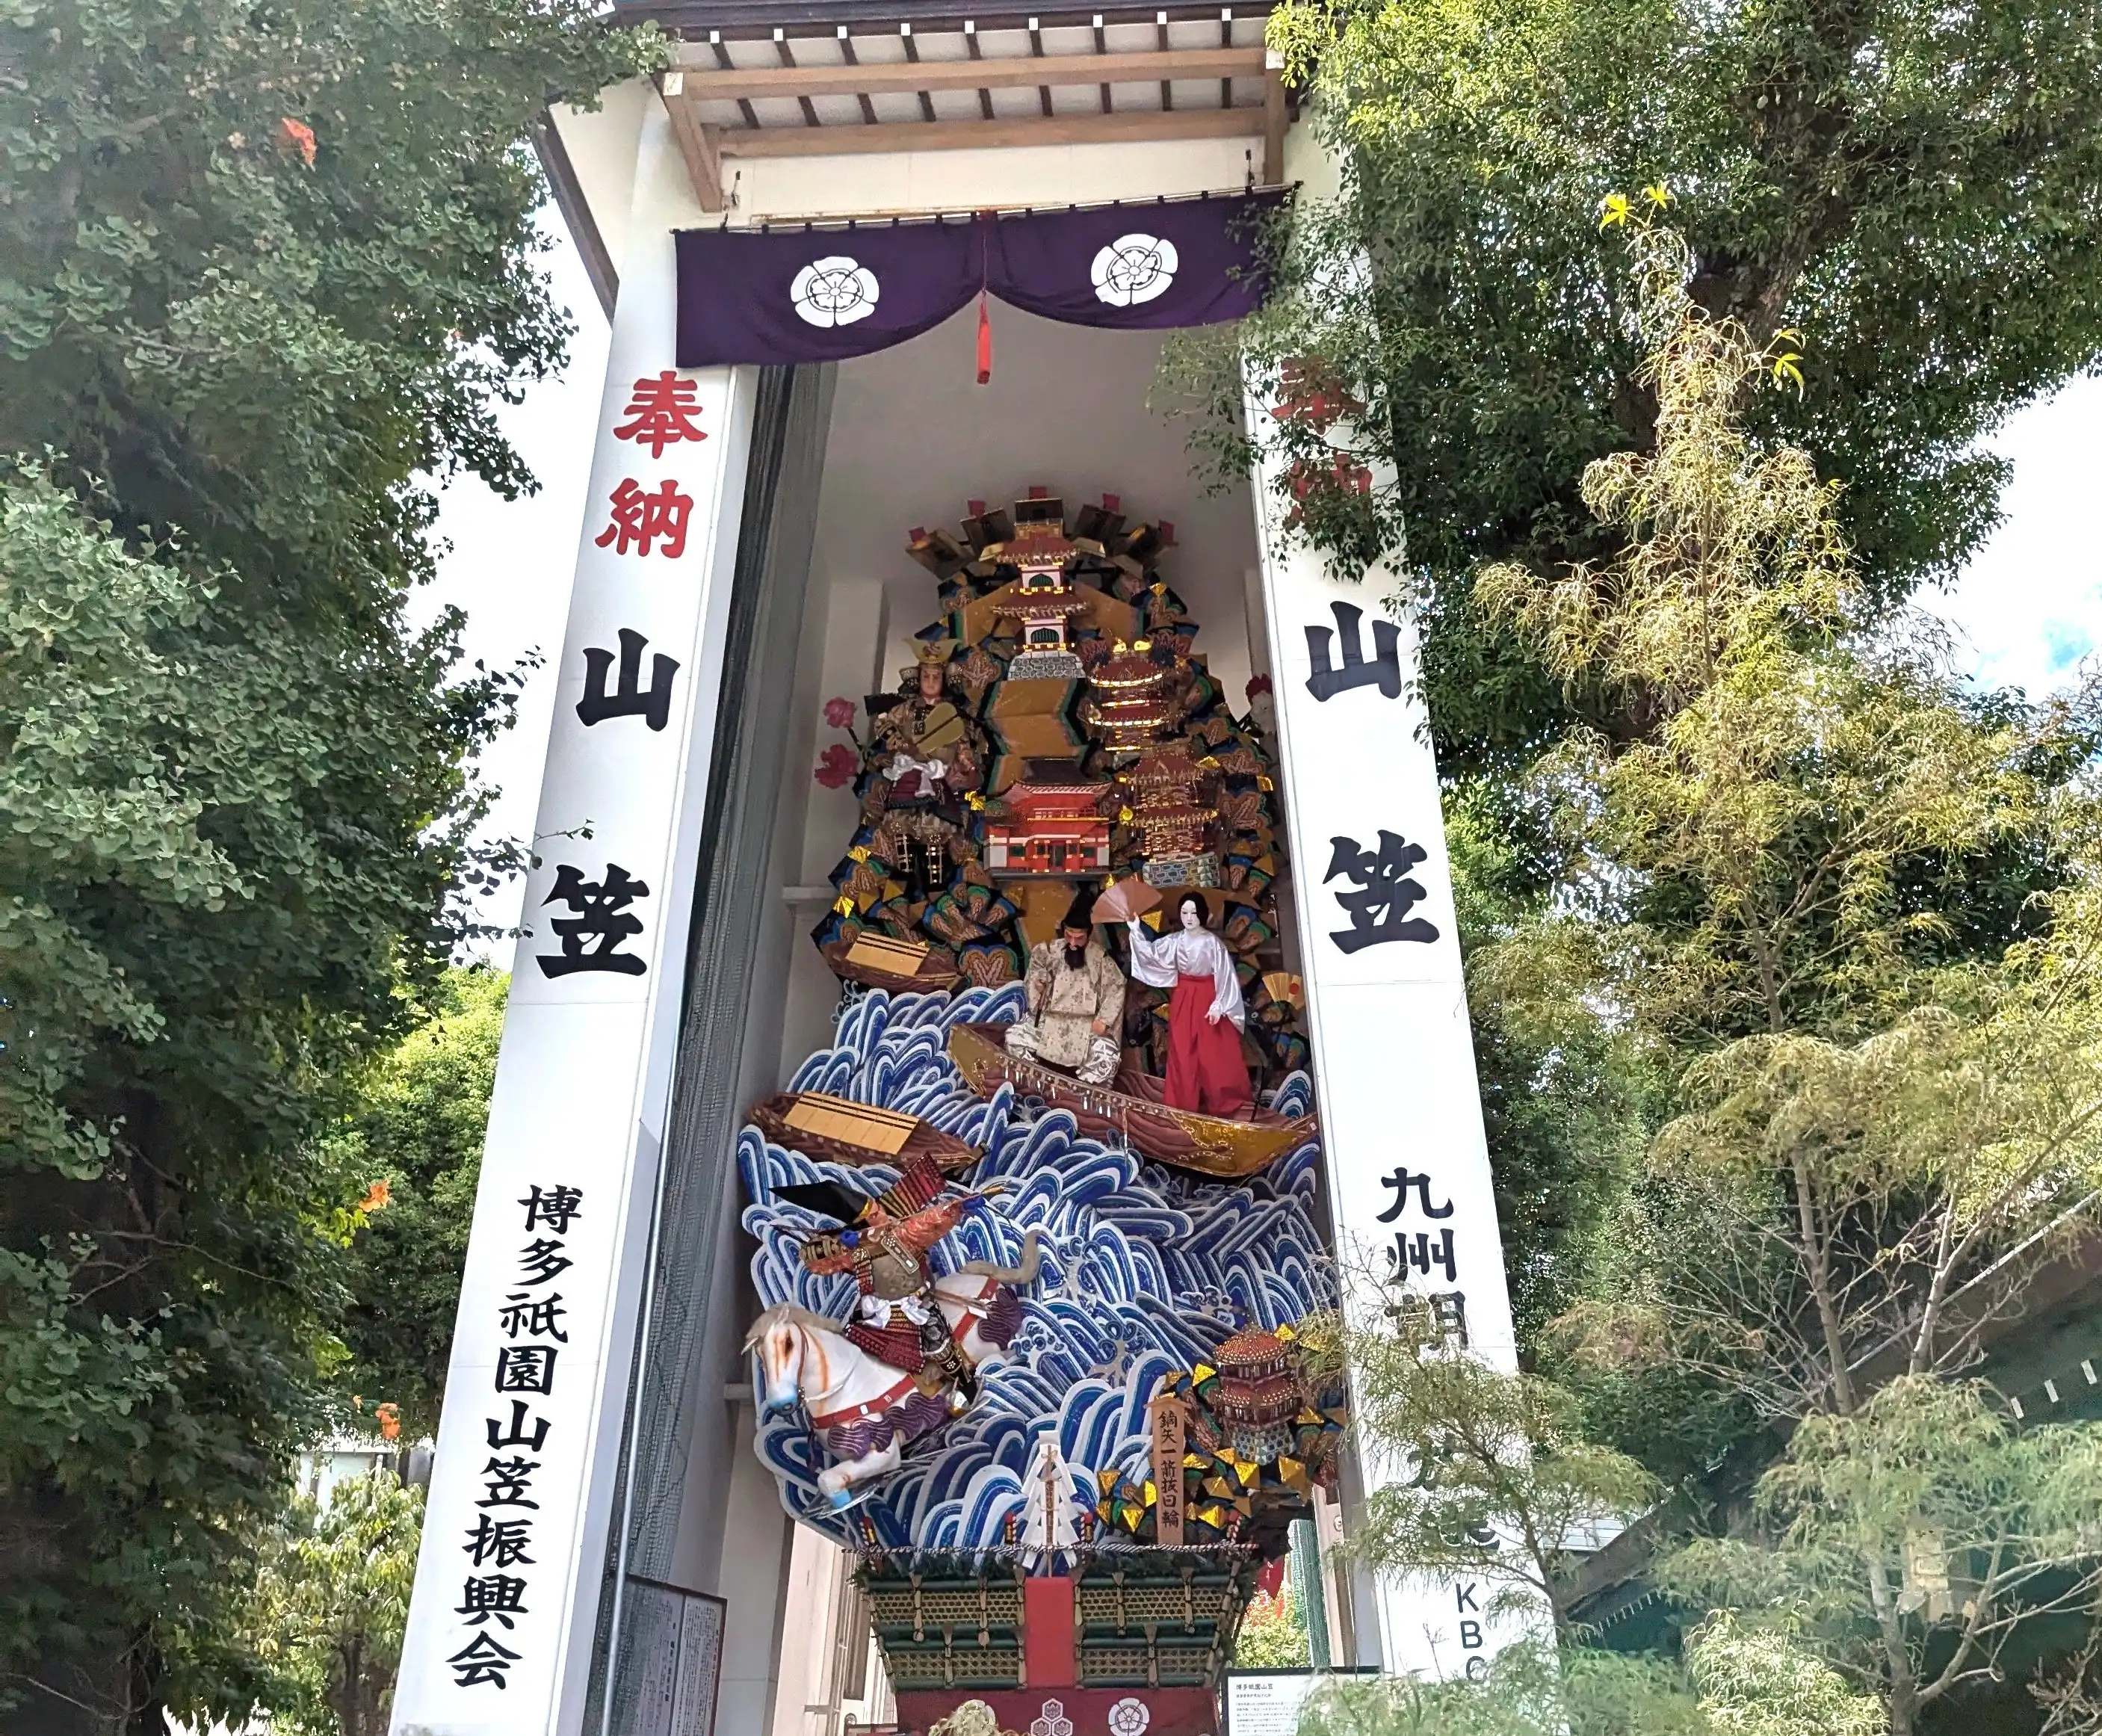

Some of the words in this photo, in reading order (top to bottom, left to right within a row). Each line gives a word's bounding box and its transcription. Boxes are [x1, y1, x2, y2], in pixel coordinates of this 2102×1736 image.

[598, 372, 708, 558] 奉納
[536, 628, 681, 980] 山笠
[1305, 600, 1440, 955] 山笠
[445, 1184, 583, 1690] 博多祇園山笠振興会
